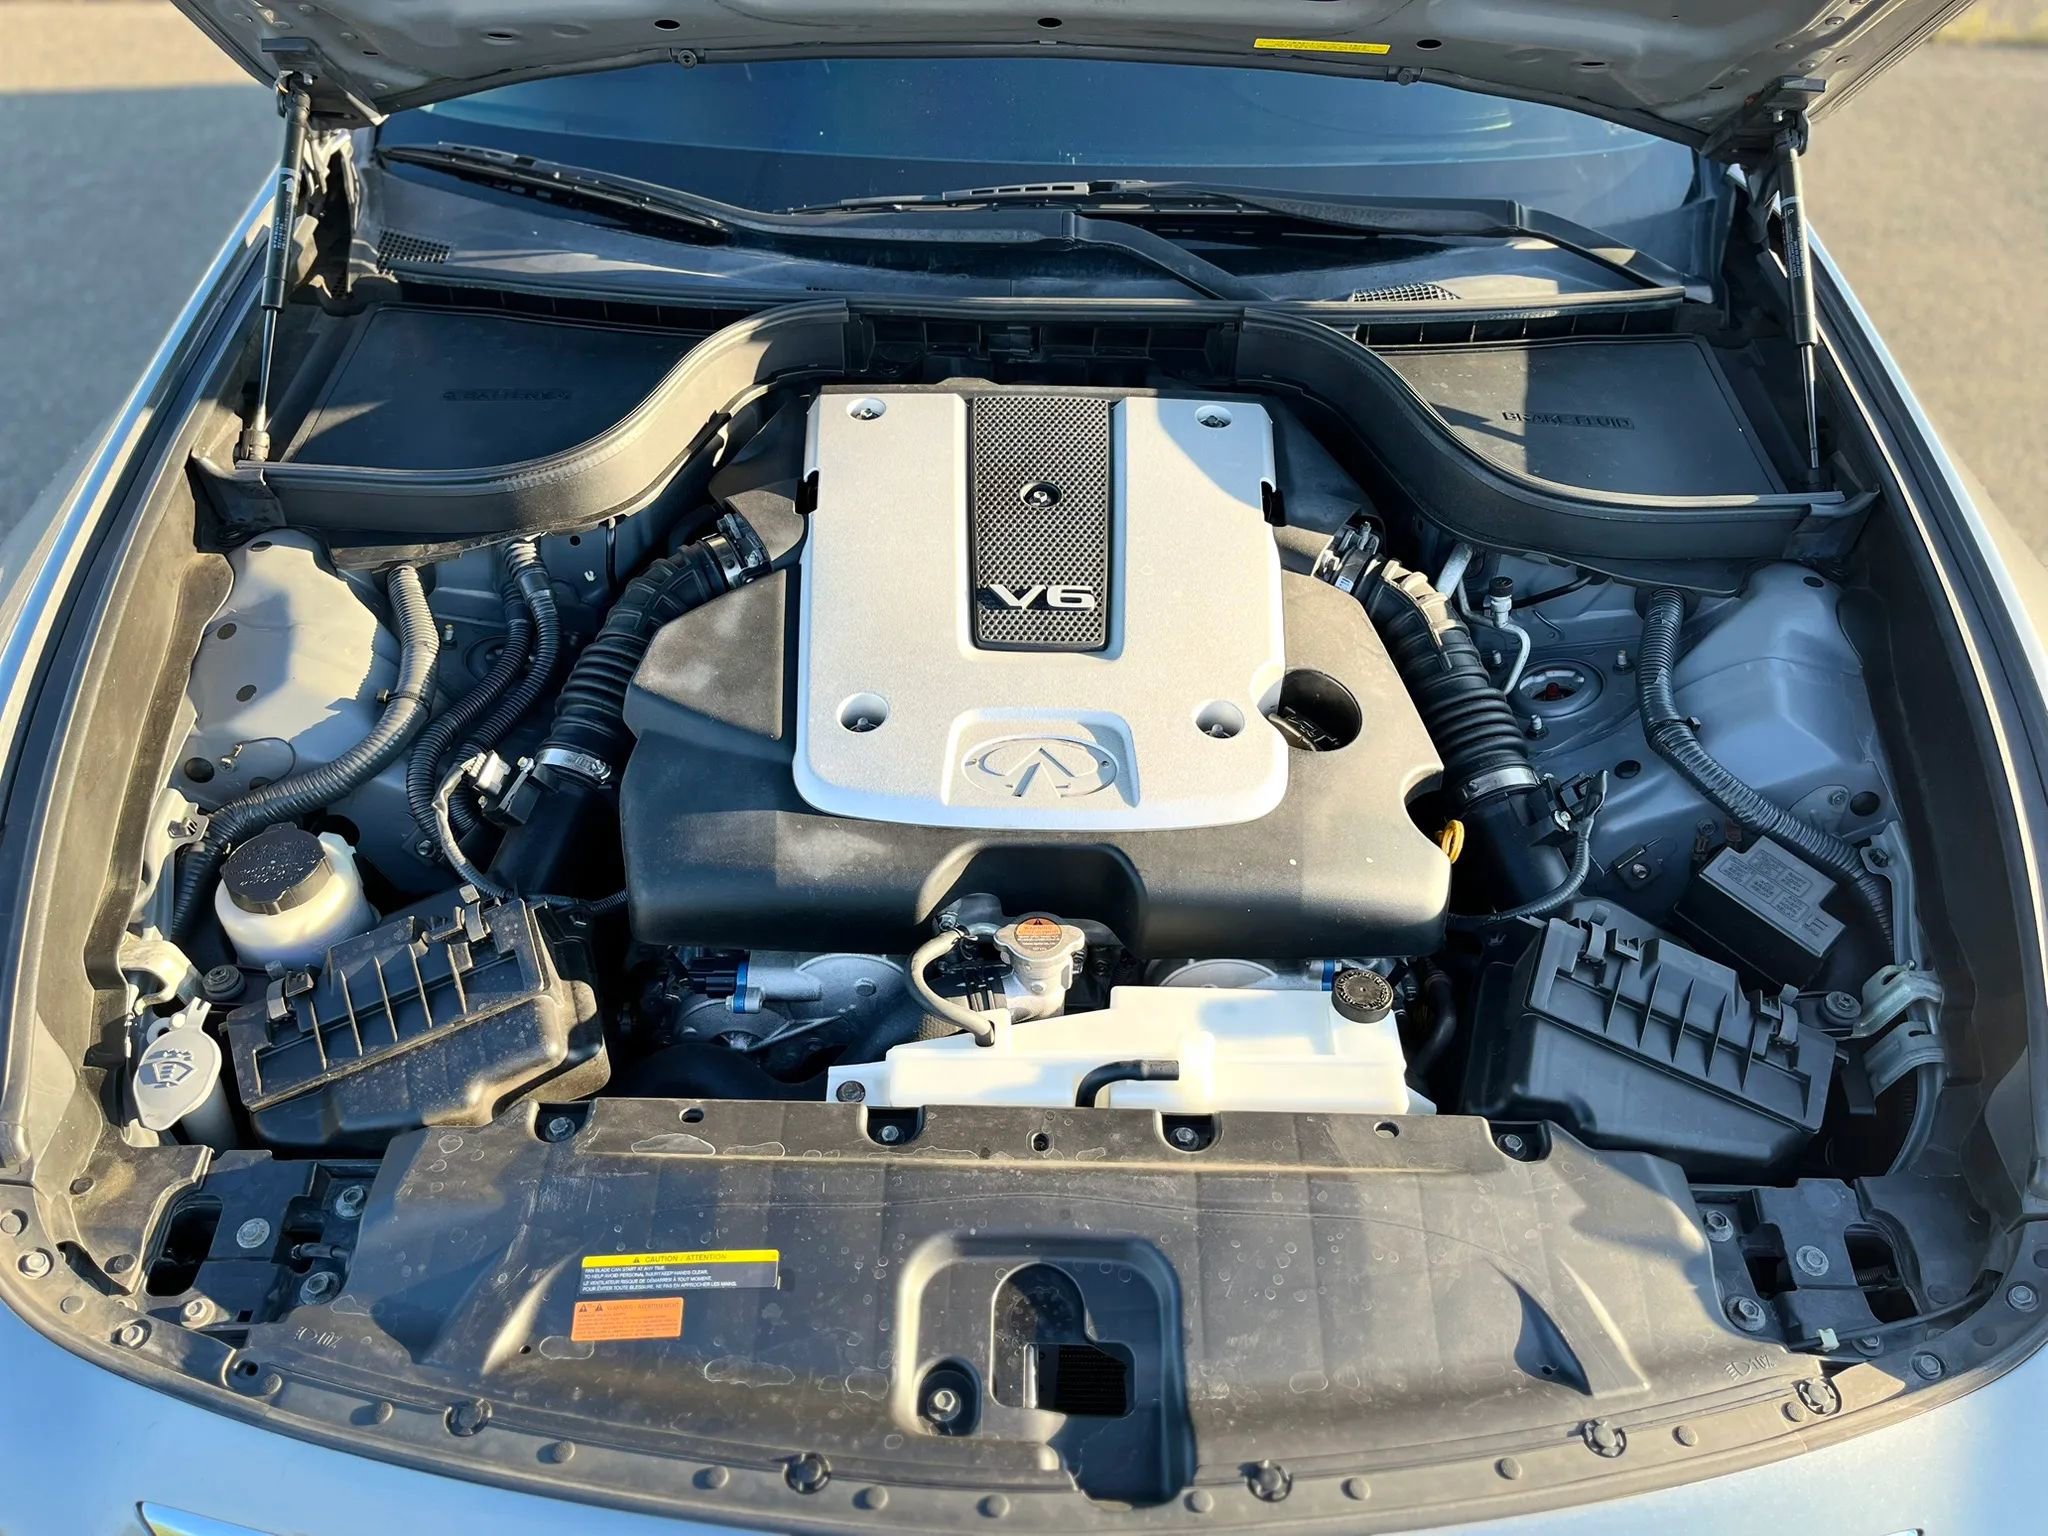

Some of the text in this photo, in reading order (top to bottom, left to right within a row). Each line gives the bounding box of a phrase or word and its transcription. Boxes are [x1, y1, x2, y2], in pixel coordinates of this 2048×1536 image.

[1502, 412, 1632, 429] BRAKE FLUID
[989, 584, 1095, 611] V6
[645, 1255, 678, 1263] CAUTION
[686, 1253, 727, 1261] ATTENTION
